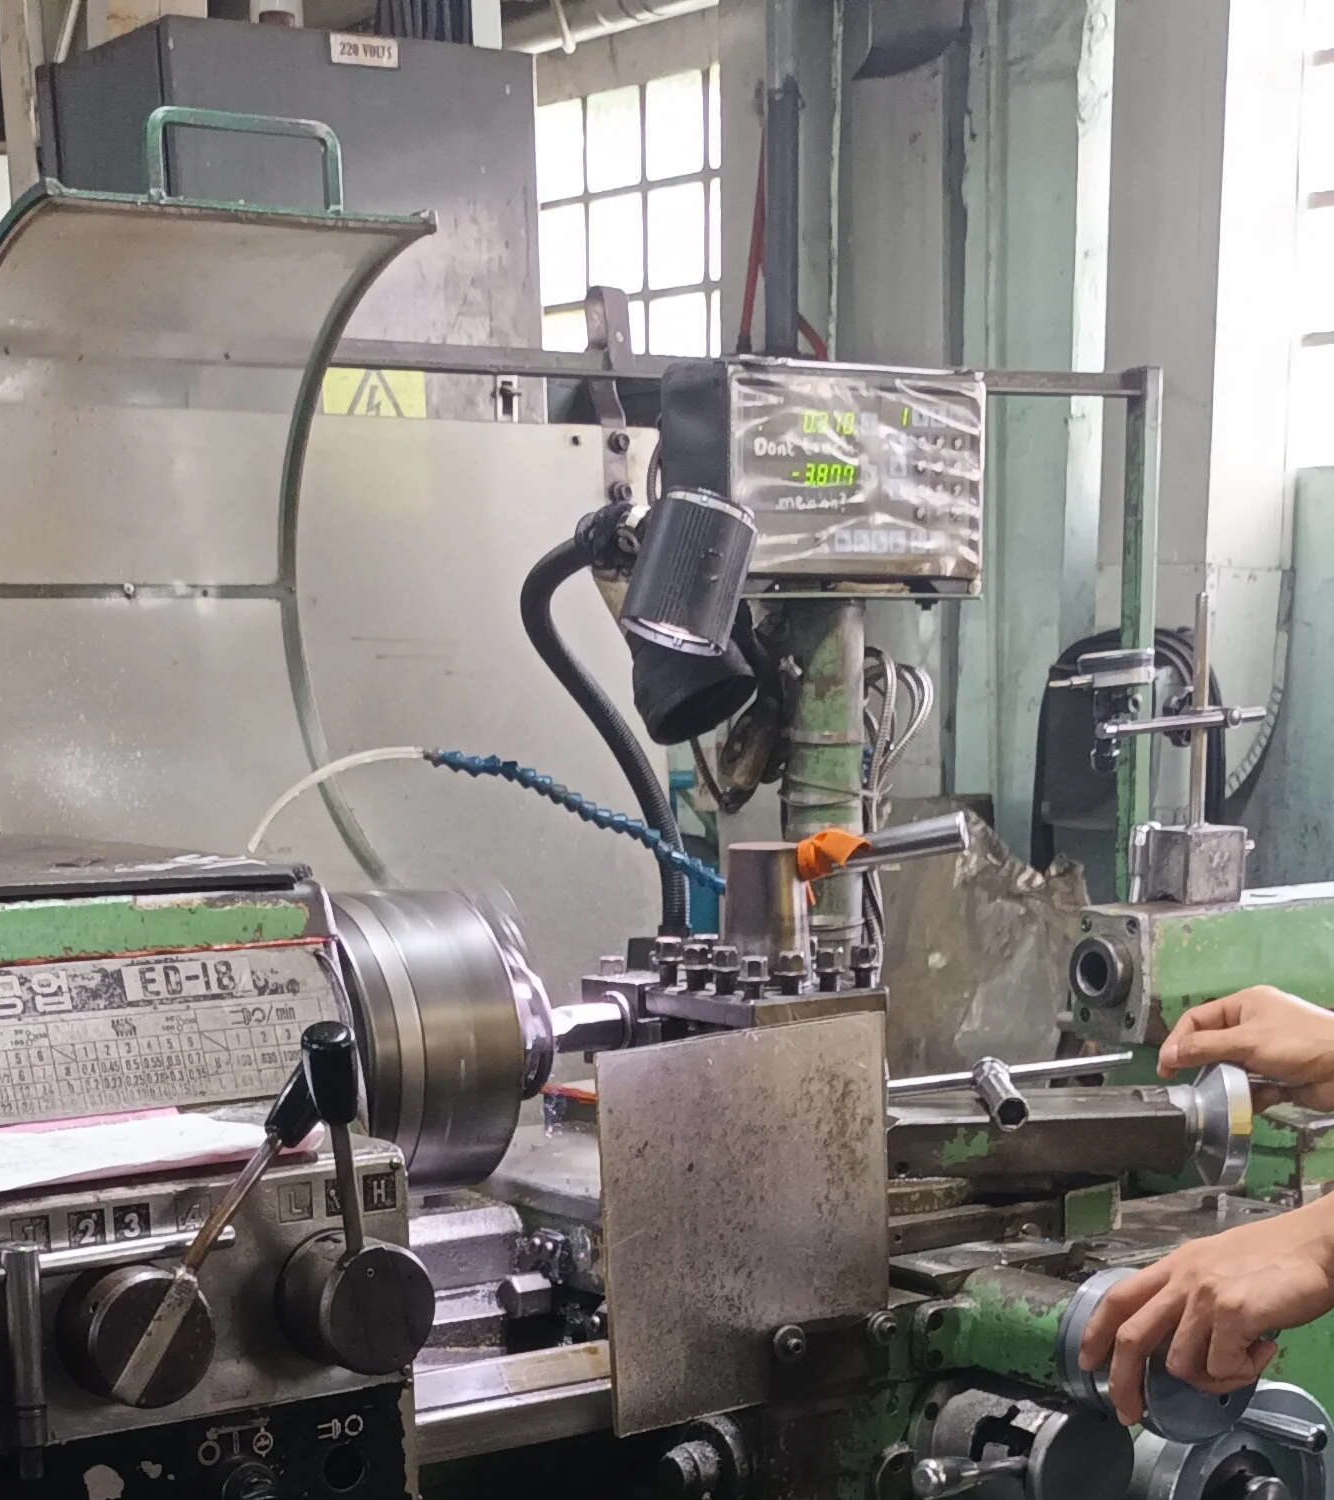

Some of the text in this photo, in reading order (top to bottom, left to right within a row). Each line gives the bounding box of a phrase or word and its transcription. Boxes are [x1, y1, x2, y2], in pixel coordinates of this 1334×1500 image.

[339, 41, 392, 60] 220 VOLTS
[754, 437, 795, 457] Dont
[372, 1179, 386, 1205] H
[78, 1218, 96, 1244] 2
[123, 1212, 141, 1238] 3
